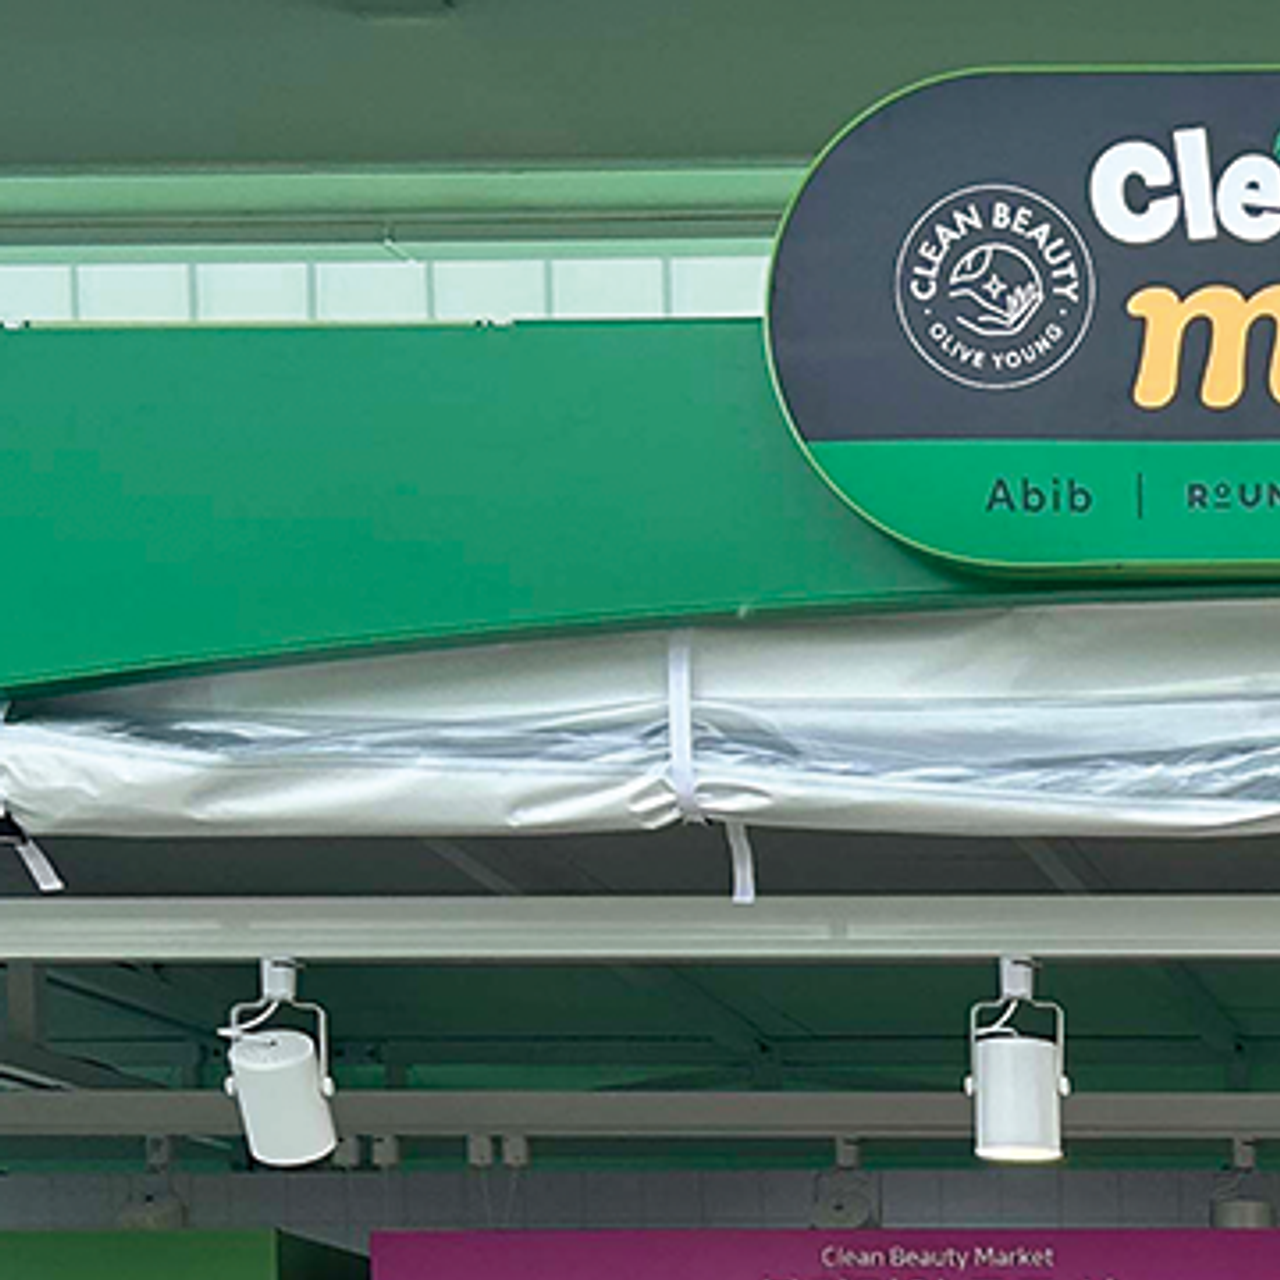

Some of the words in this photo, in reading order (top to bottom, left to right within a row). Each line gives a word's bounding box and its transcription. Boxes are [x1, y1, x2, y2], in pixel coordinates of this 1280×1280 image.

[910, 203, 984, 301] CLEAN
[992, 202, 1080, 303] BEAUTY
[929, 322, 986, 369] OLIVE
[992, 322, 1064, 370] YOUNG
[984, 477, 1094, 514] Abib
[821, 1247, 885, 1267] Clean
[889, 1246, 968, 1270] Beauty
[974, 1246, 1055, 1267] Market
